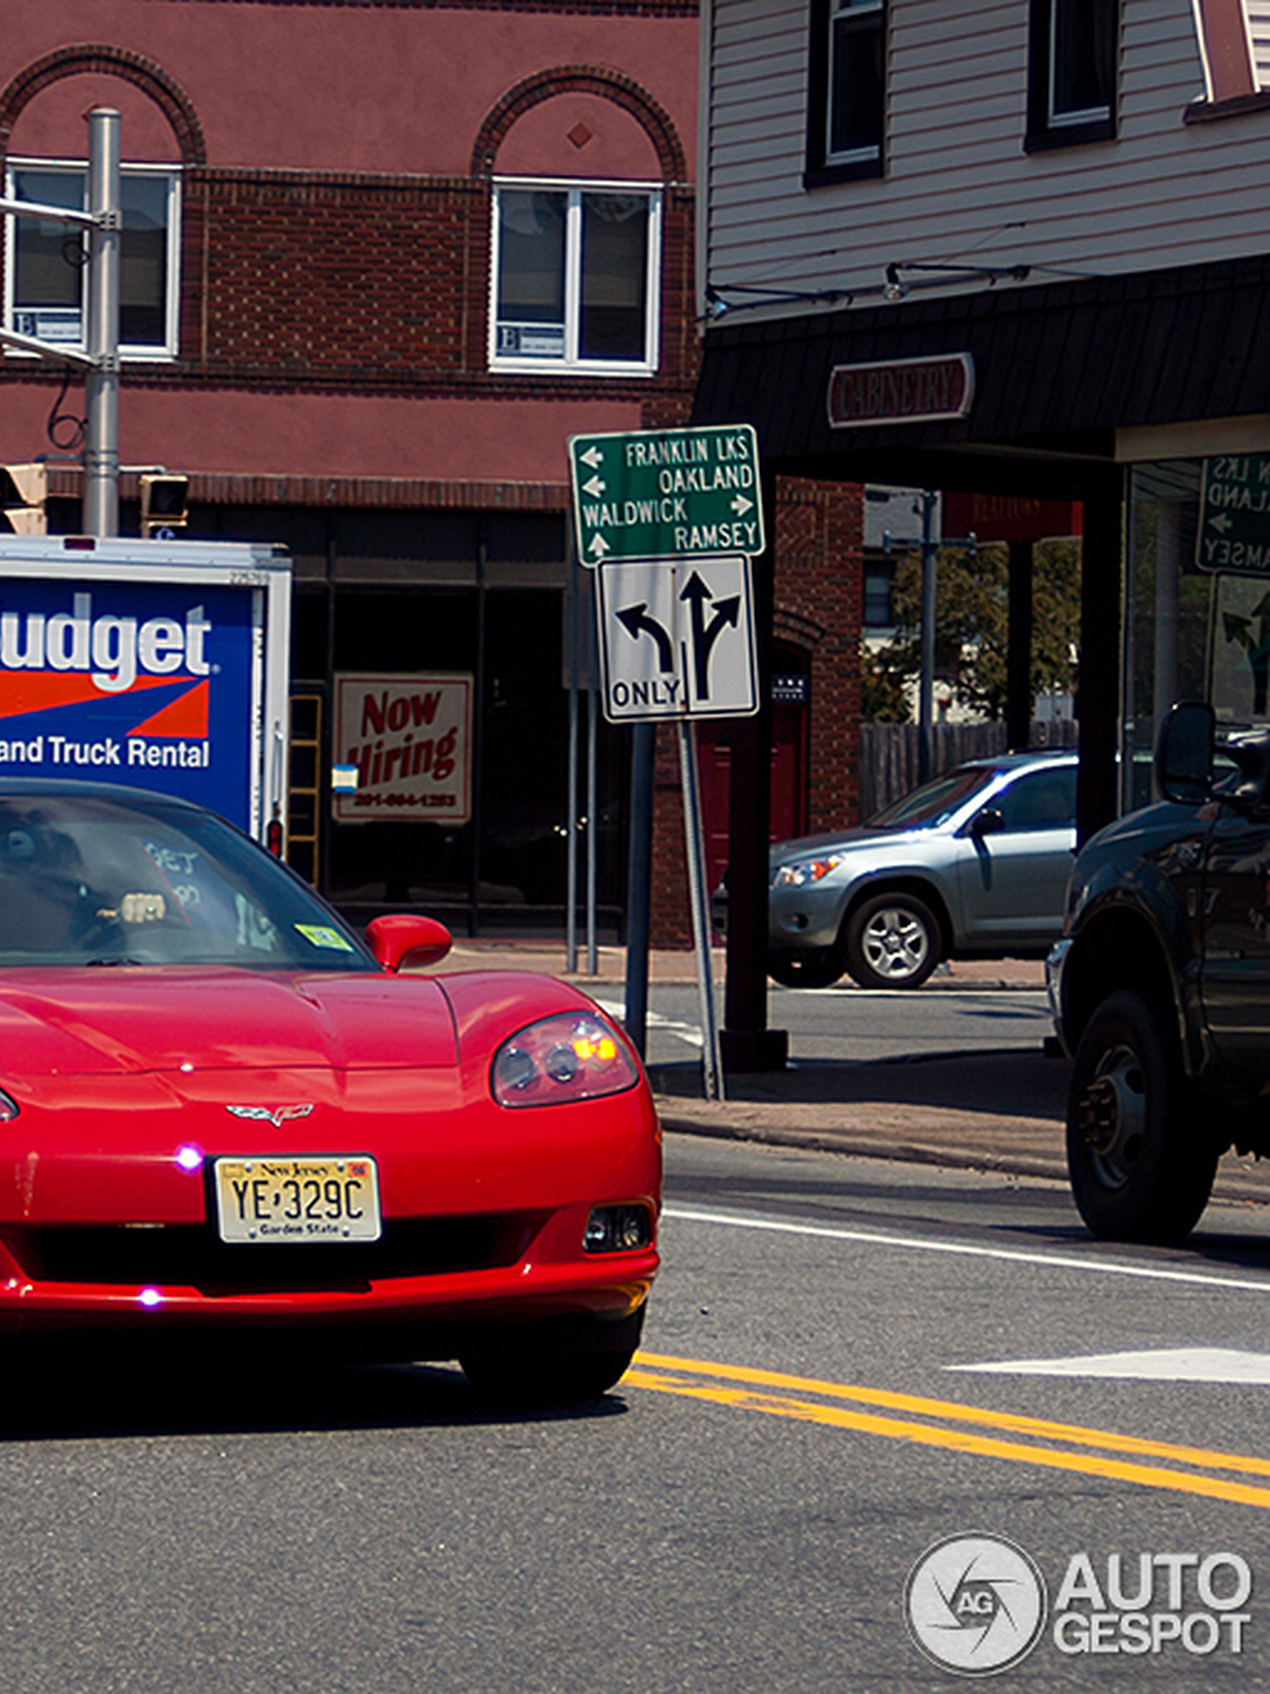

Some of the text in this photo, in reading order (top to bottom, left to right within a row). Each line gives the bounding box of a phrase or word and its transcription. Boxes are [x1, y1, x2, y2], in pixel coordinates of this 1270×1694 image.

[839, 365, 957, 418] CABINETRY
[626, 435, 749, 467] FRANKLIN LKS
[659, 464, 752, 494] OAKLAND
[583, 498, 688, 528] WALDWICK
[675, 522, 757, 550] RAMSEY
[612, 679, 680, 706] ONLY
[361, 690, 442, 737] Now
[48, 736, 120, 765] Truck
[128, 738, 210, 767] Rental
[347, 726, 458, 789] Hiring
[261, 1162, 329, 1178] New Jersey
[260, 1223, 338, 1235] Garden State
